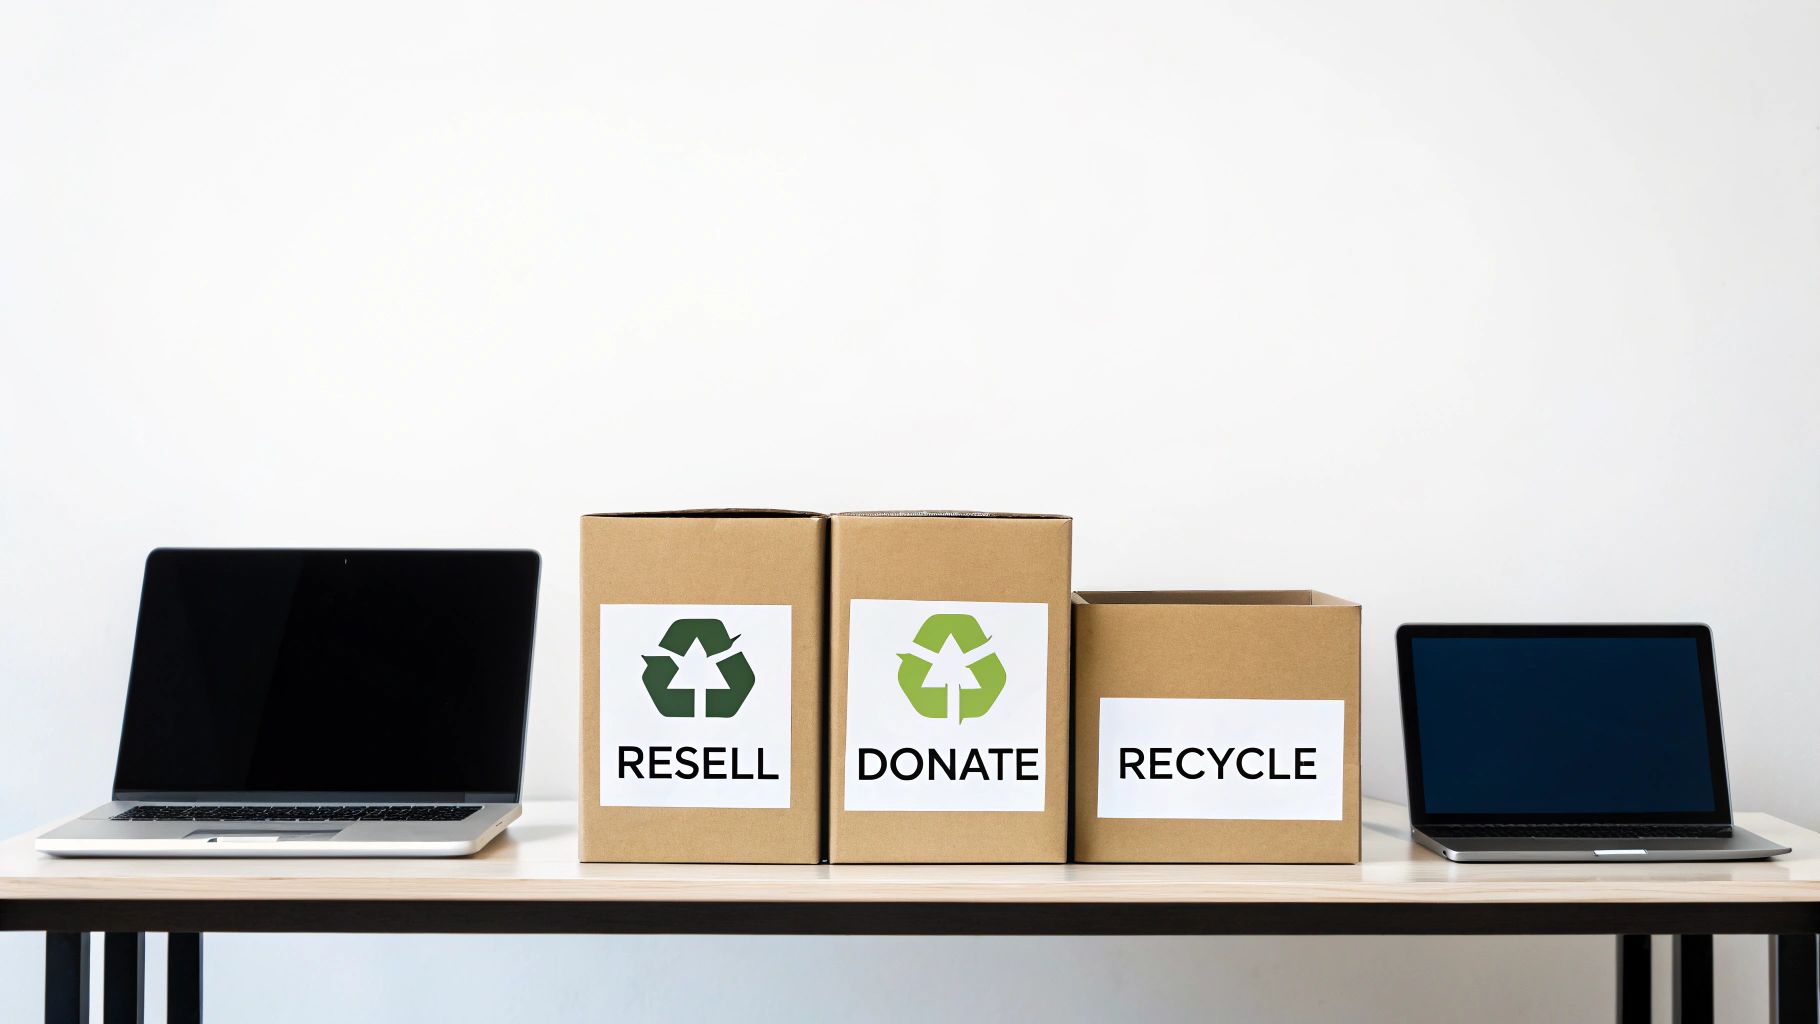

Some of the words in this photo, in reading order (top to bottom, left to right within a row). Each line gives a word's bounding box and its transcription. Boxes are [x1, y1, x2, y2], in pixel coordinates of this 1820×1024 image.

[618, 746, 780, 780] RESELL
[858, 747, 1039, 781] DONATE
[1119, 747, 1317, 780] RECYCLE
